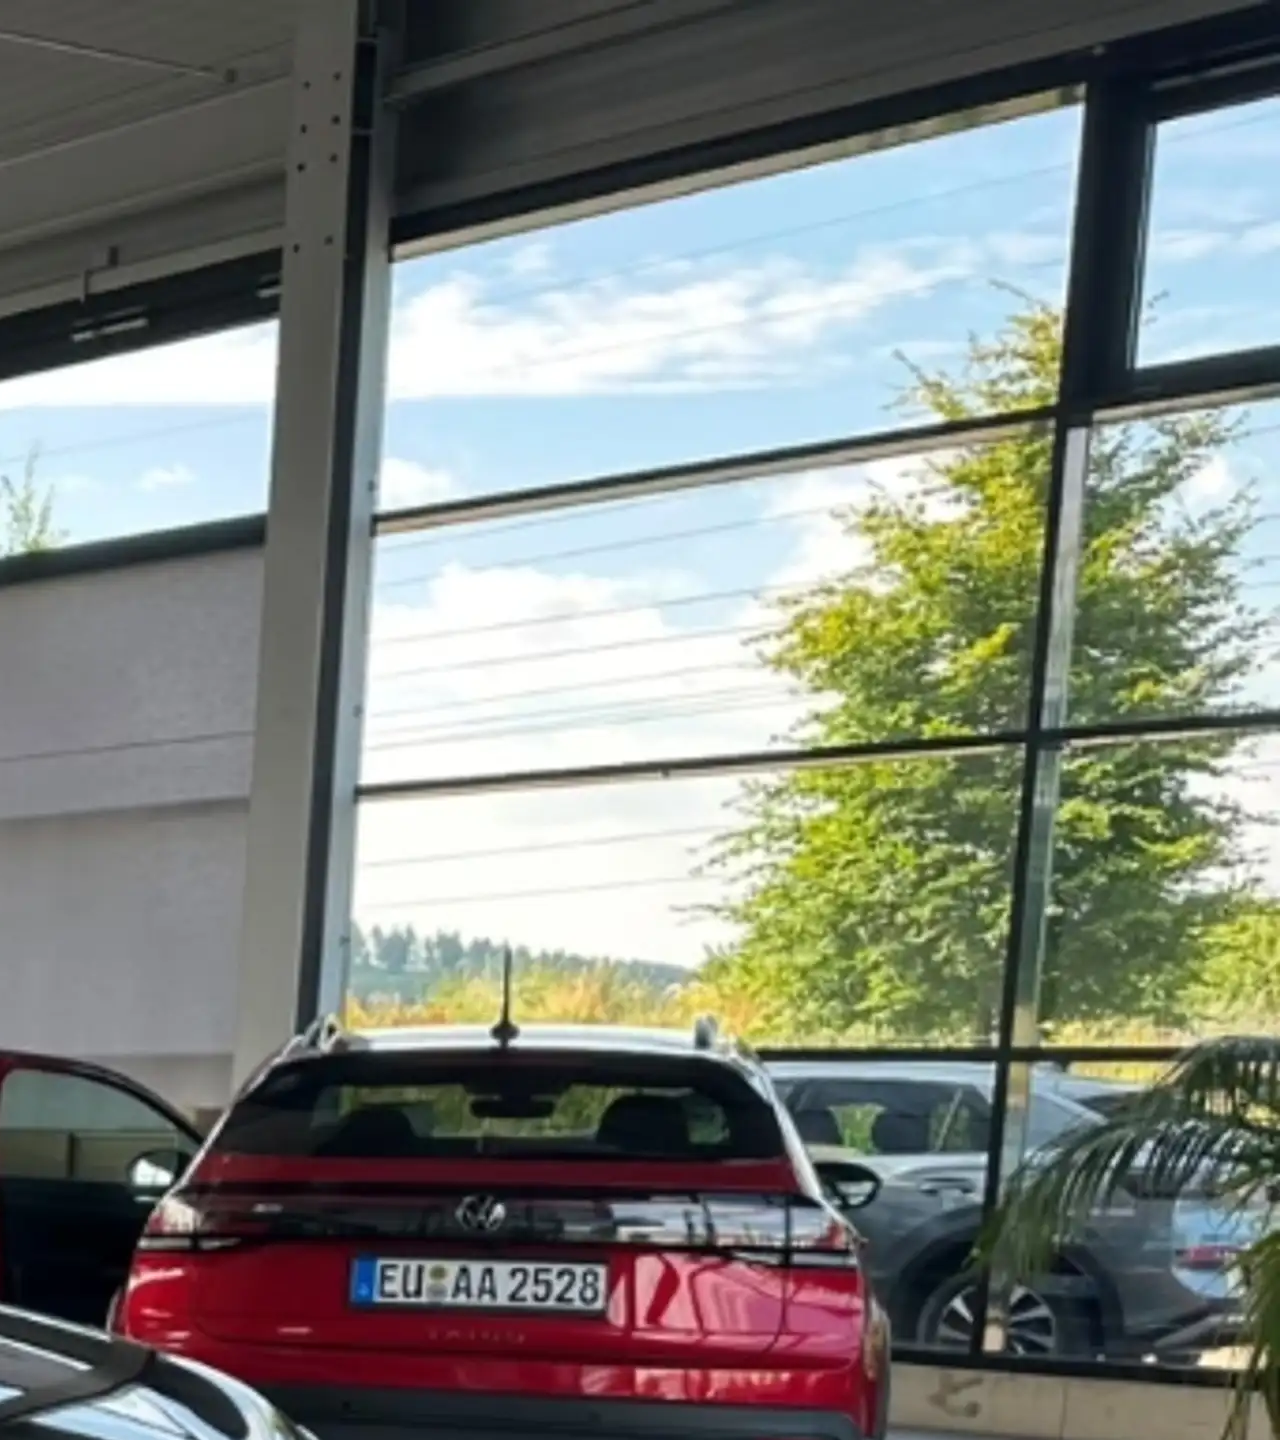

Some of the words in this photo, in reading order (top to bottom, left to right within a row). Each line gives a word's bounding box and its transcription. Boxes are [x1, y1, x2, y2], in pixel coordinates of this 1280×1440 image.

[378, 1264, 425, 1299] EU
[451, 1265, 498, 1302] AA
[507, 1267, 600, 1306] 2528
